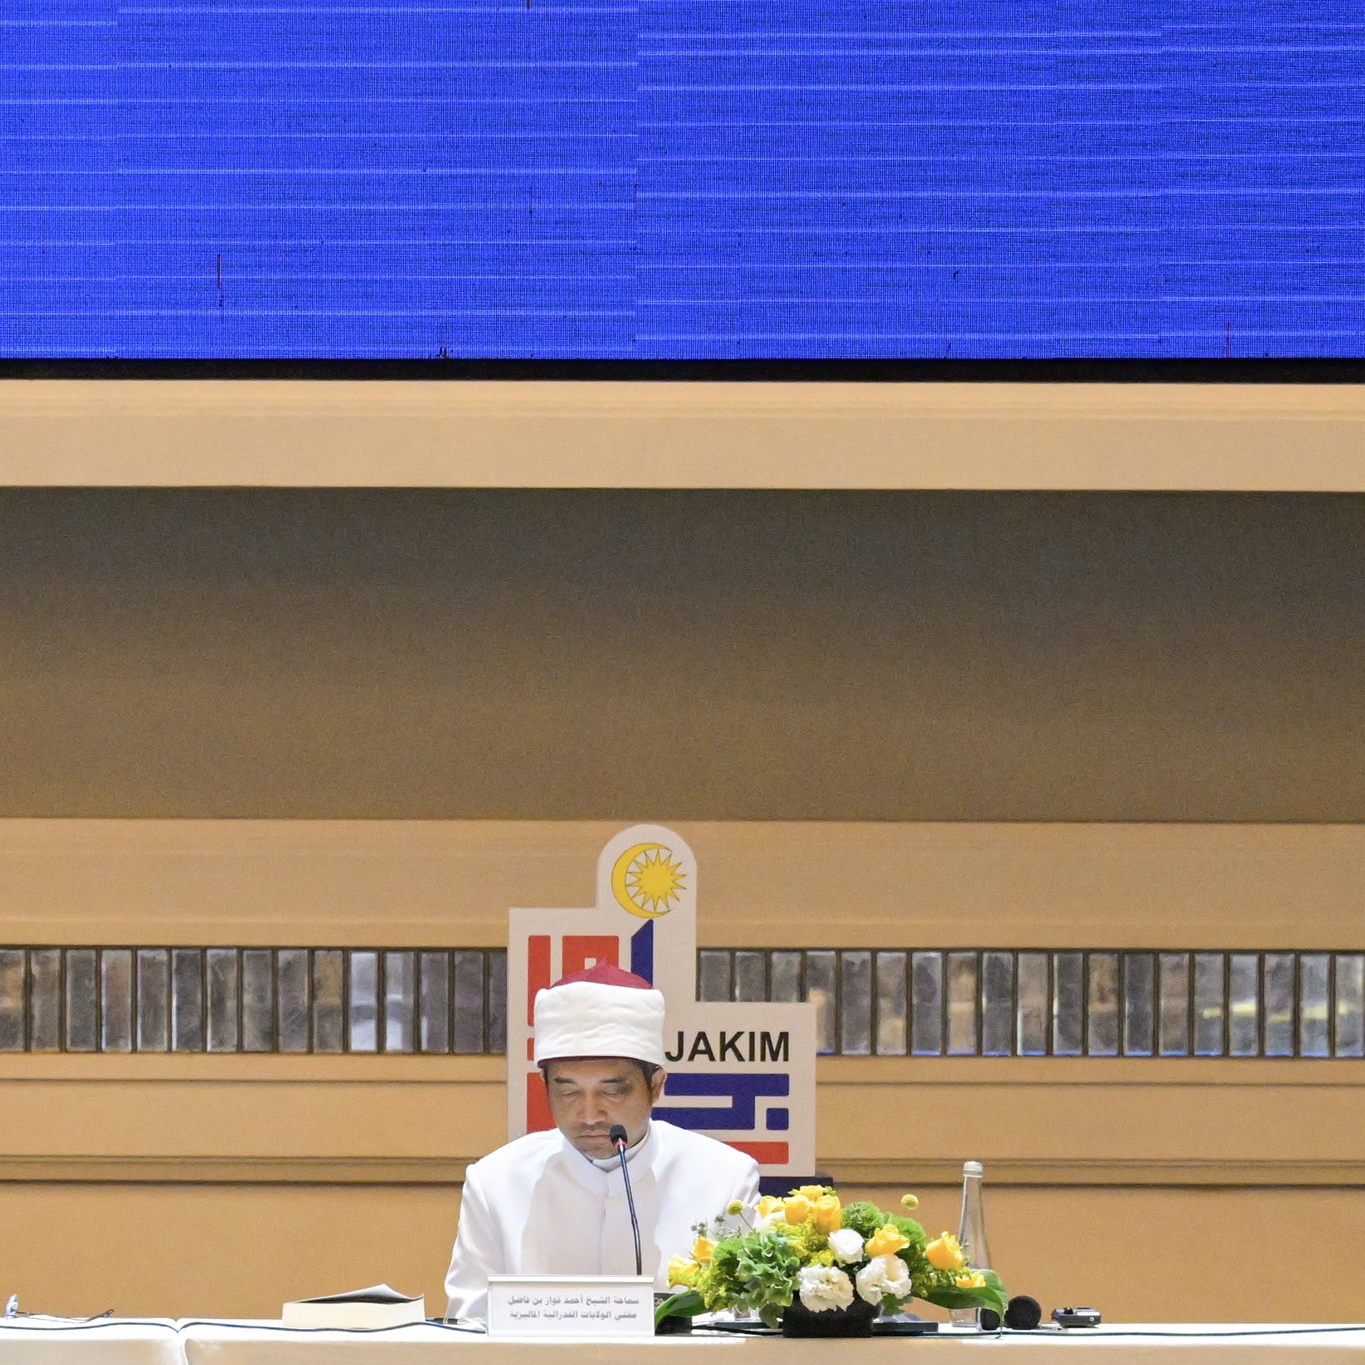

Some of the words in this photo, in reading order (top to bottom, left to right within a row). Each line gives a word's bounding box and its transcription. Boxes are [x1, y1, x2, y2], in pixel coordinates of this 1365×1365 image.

[664, 1030, 790, 1063] JAKIM
[563, 1293, 584, 1305] أحمد
[586, 1295, 611, 1306] الشيخ
[613, 1295, 640, 1305] سماحة
[580, 1310, 612, 1320] الولايات
